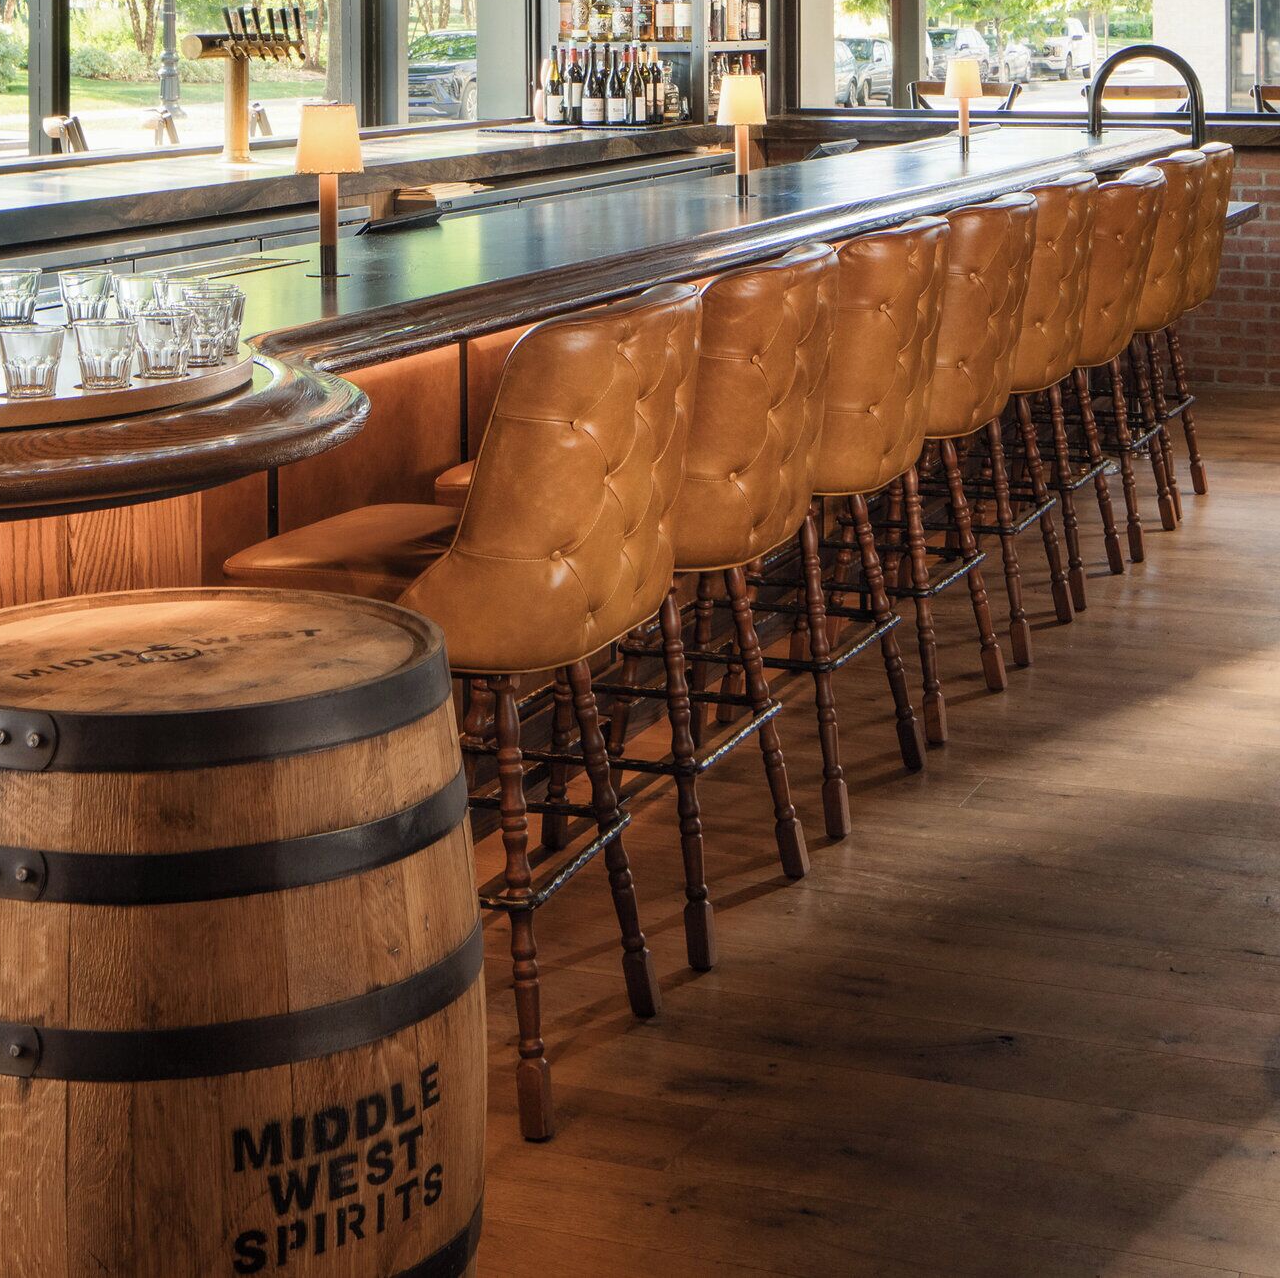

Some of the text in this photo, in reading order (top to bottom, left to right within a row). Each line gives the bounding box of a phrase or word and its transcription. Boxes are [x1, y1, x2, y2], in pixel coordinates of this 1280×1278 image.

[11, 628, 322, 680] MIDDLE WEST
[232, 1061, 441, 1173] MIDDLE
[232, 1162, 443, 1275] SPIRITS
[267, 1124, 424, 1217] WEST
